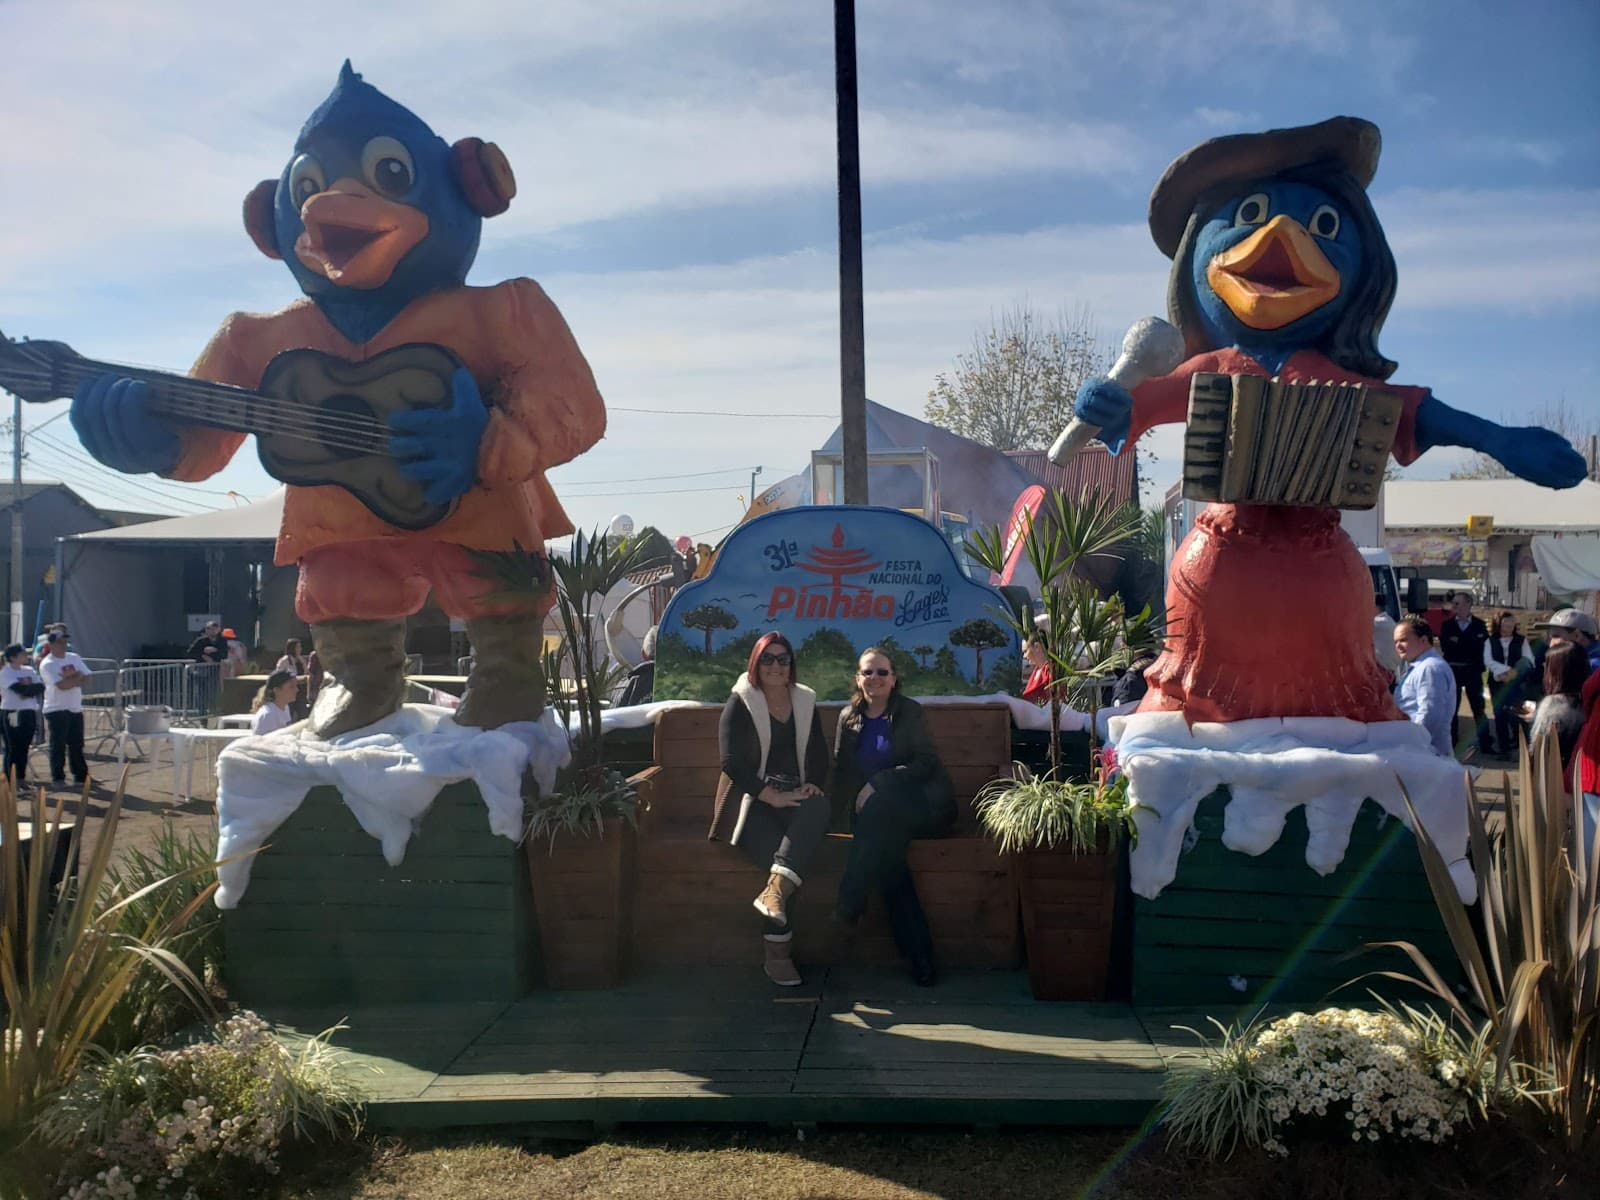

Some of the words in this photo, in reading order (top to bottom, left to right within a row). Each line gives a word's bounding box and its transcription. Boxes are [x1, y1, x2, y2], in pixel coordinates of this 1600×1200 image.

[885, 560, 922, 571] FESTA
[868, 573, 923, 585] NACIONAL
[926, 573, 942, 584] DO
[767, 586, 896, 618] Pinhão
[895, 584, 950, 627] Lages
